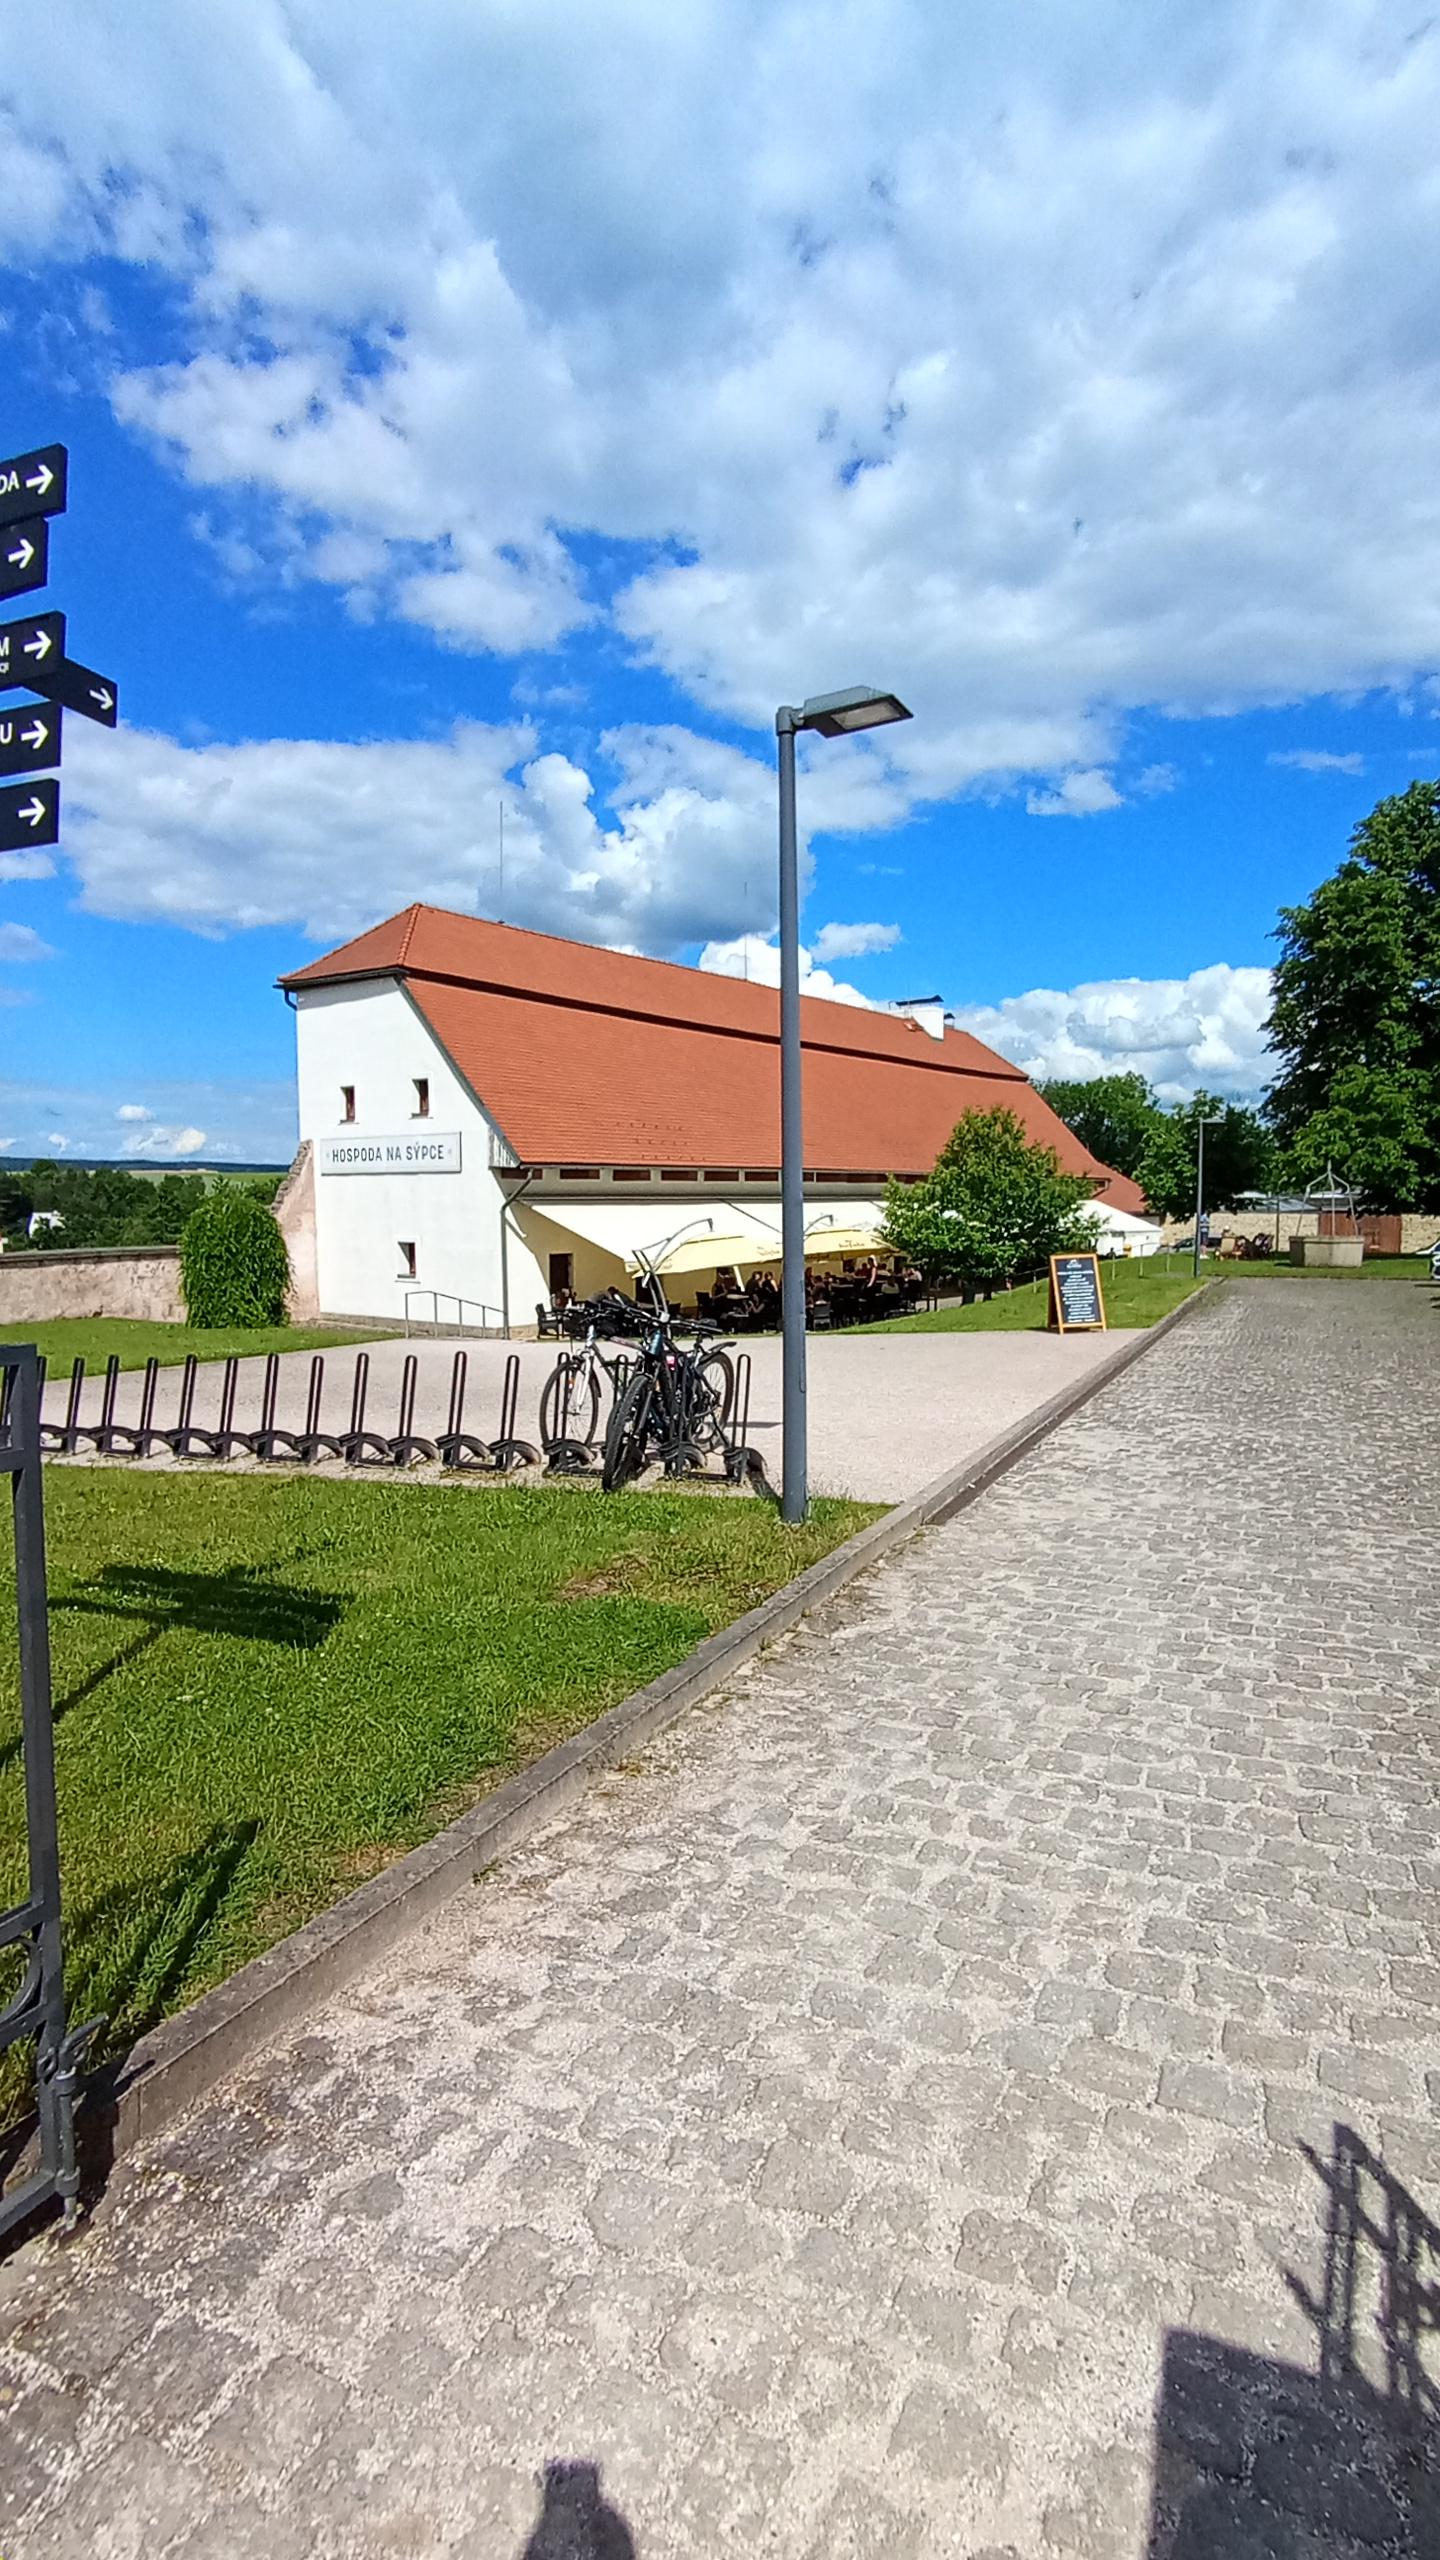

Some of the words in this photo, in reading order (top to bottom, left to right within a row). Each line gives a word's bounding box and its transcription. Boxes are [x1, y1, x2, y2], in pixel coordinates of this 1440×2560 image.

[332, 1147, 383, 1163] HOSPODA
[386, 1145, 402, 1161] NA
[405, 1142, 445, 1161] SÝPCE
